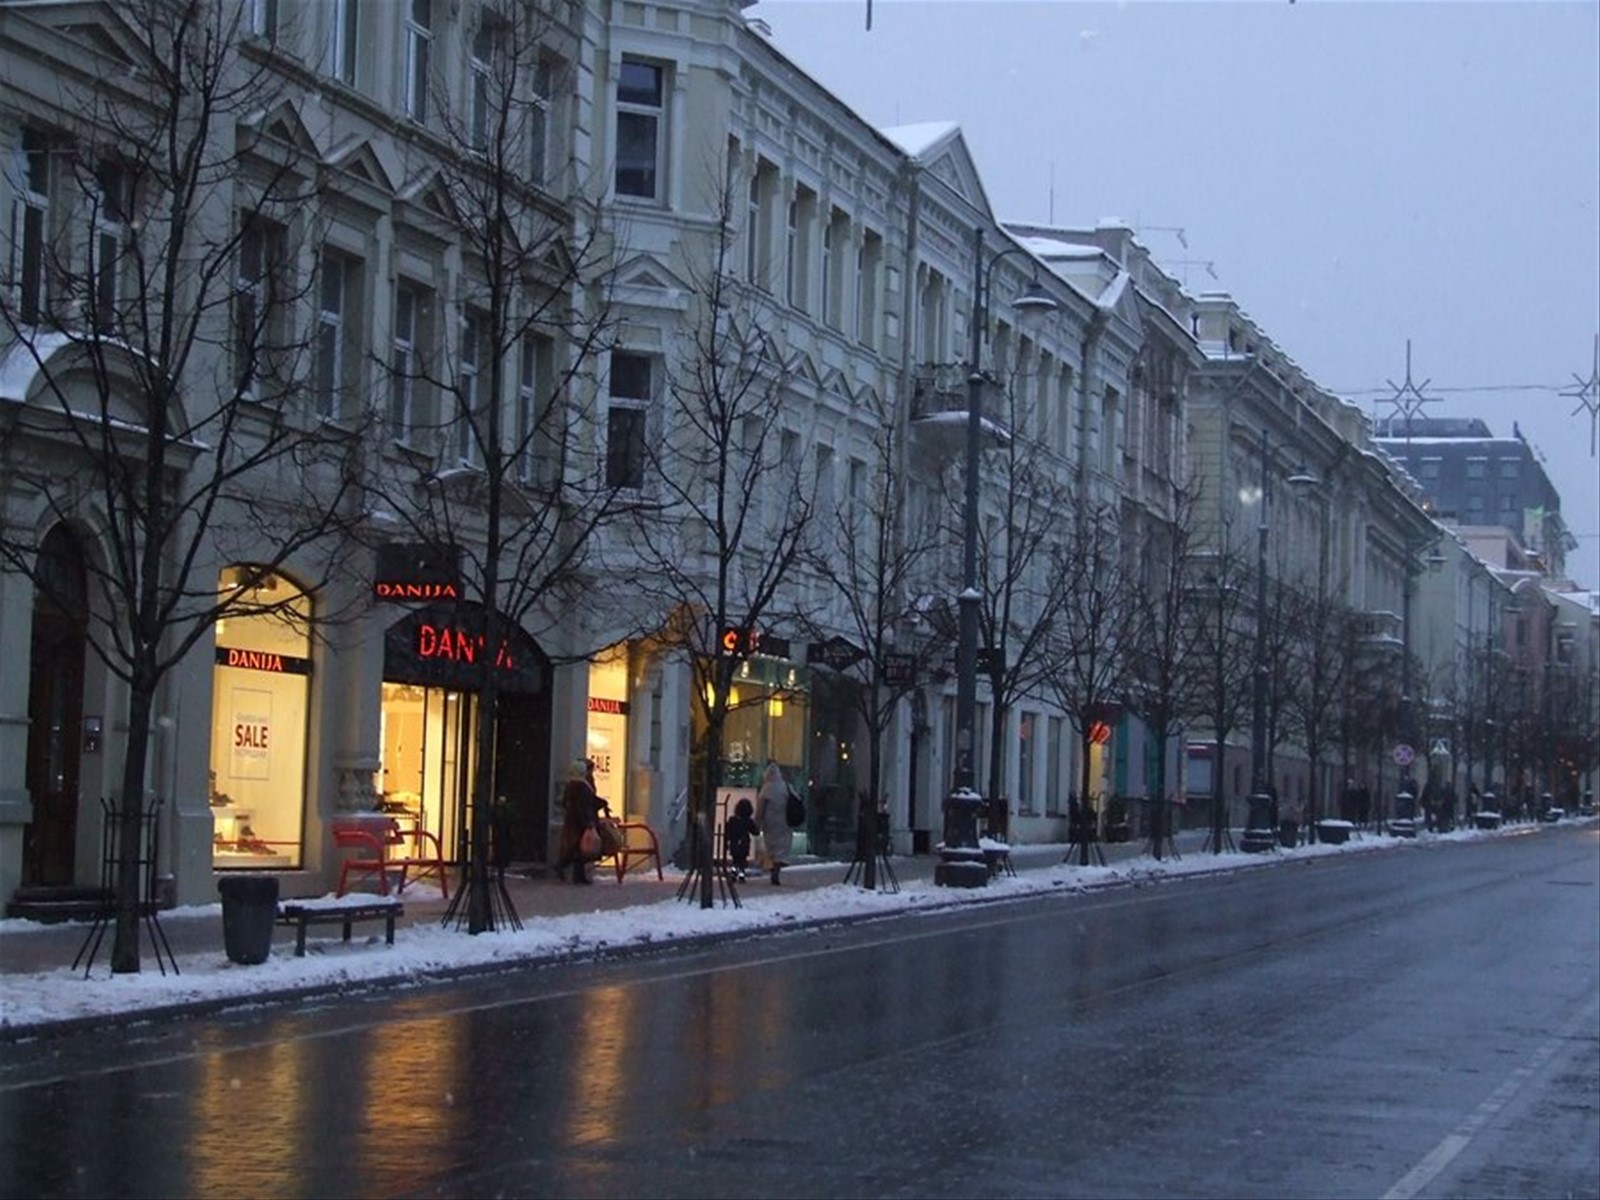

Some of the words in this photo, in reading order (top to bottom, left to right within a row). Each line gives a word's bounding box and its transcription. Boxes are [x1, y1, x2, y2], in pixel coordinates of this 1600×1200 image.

[376, 583, 456, 598] DANIJA
[228, 649, 282, 672] DANIJA
[587, 698, 621, 714] DANIJA
[235, 724, 268, 748] SALE
